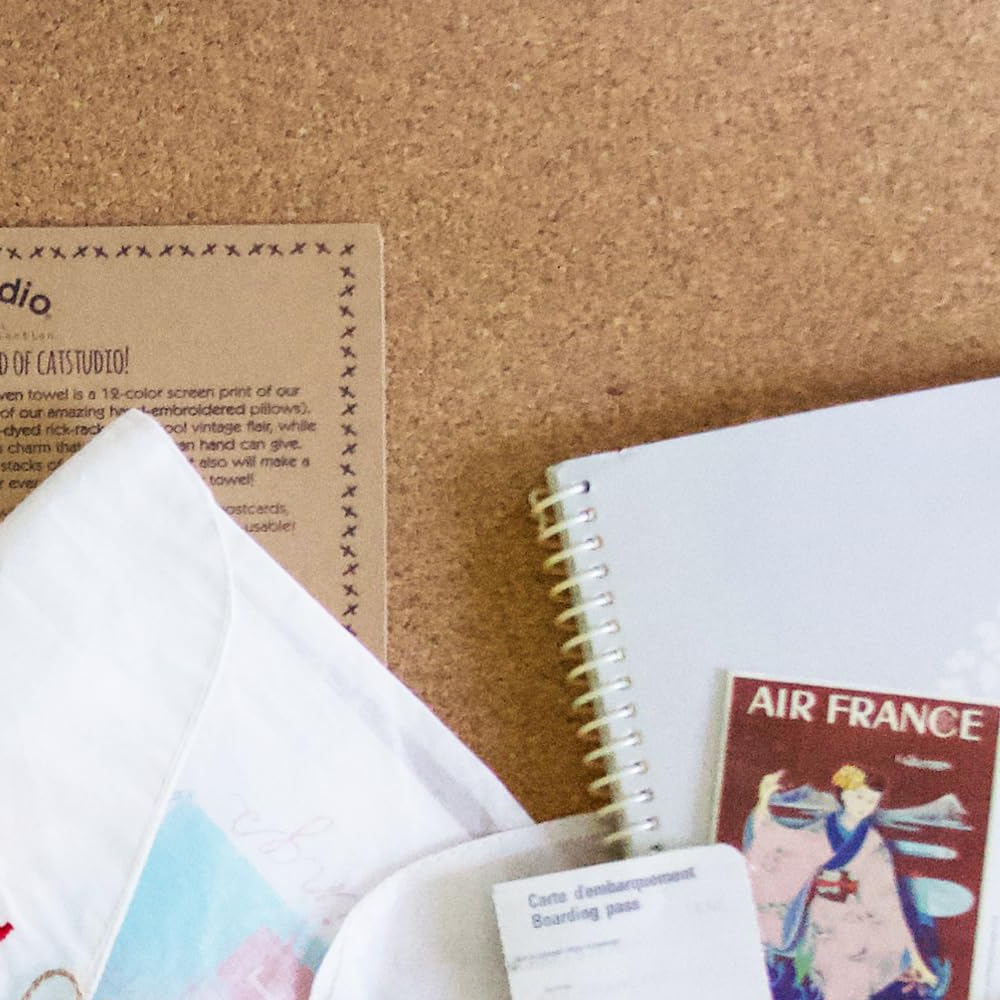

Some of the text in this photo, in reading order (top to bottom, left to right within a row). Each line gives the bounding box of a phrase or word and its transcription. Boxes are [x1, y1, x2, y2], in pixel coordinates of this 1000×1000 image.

[28, 388, 69, 400] towel
[73, 388, 85, 400] is
[88, 391, 96, 400] a
[102, 387, 163, 400] 12-color
[167, 388, 214, 399] screen
[218, 386, 252, 401] print
[255, 385, 273, 397] of
[276, 386, 301, 397] our
[0, 406, 16, 419] of
[19, 407, 42, 418] our
[47, 405, 105, 420] amazing
[192, 423, 242, 435] vintage
[279, 420, 317, 432] while
[7, 442, 51, 453] charm
[199, 440, 235, 450] hand
[240, 440, 266, 450] can
[1, 460, 42, 472] stacks
[199, 457, 228, 468] also
[260, 457, 297, 468] make
[301, 457, 310, 467] a
[746, 685, 985, 743] AIR FRANCE
[527, 889, 567, 909] Carte
[531, 899, 640, 929] Boarding pass
